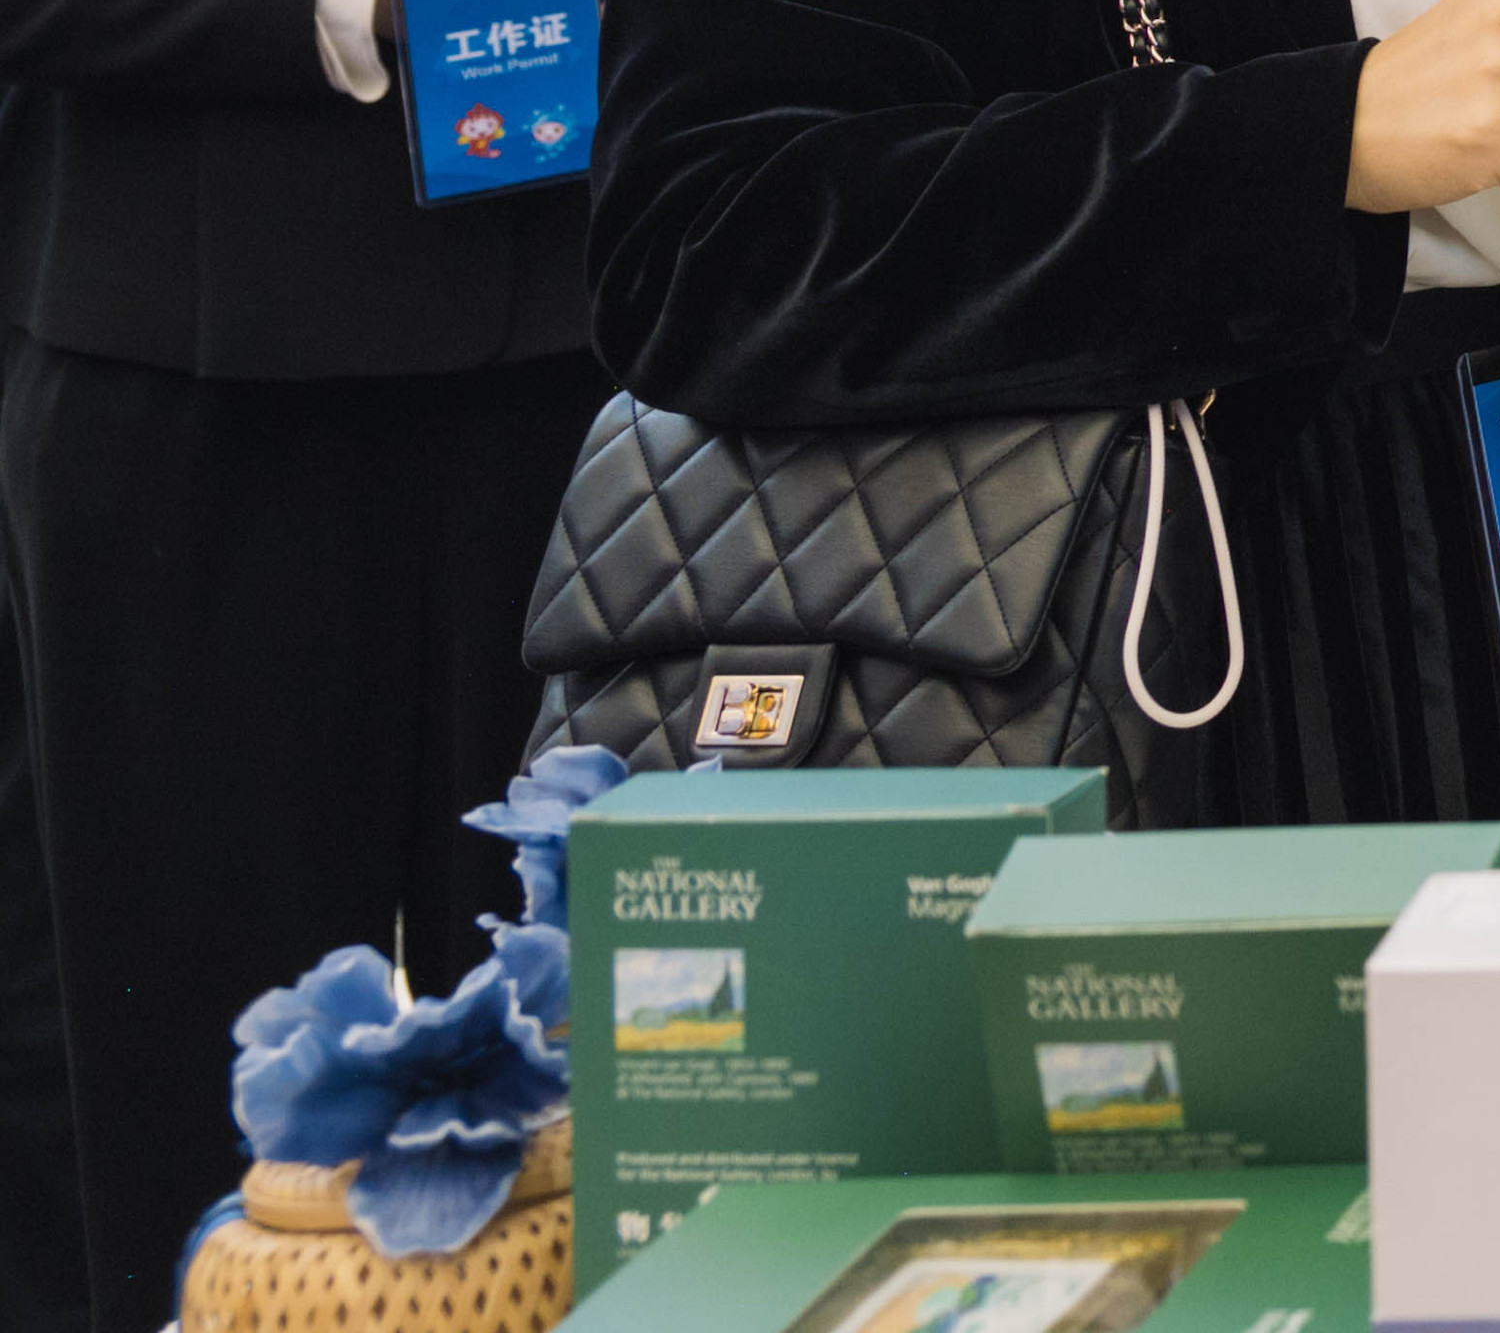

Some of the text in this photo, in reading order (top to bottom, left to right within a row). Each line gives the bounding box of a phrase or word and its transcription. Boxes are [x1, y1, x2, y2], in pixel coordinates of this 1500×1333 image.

[445, 11, 571, 63] 工作证
[614, 869, 762, 894] NATIONAL
[613, 893, 763, 922] GALLERY
[1026, 973, 1180, 999] NATIONAL
[1027, 993, 1185, 1020] GALLERY
